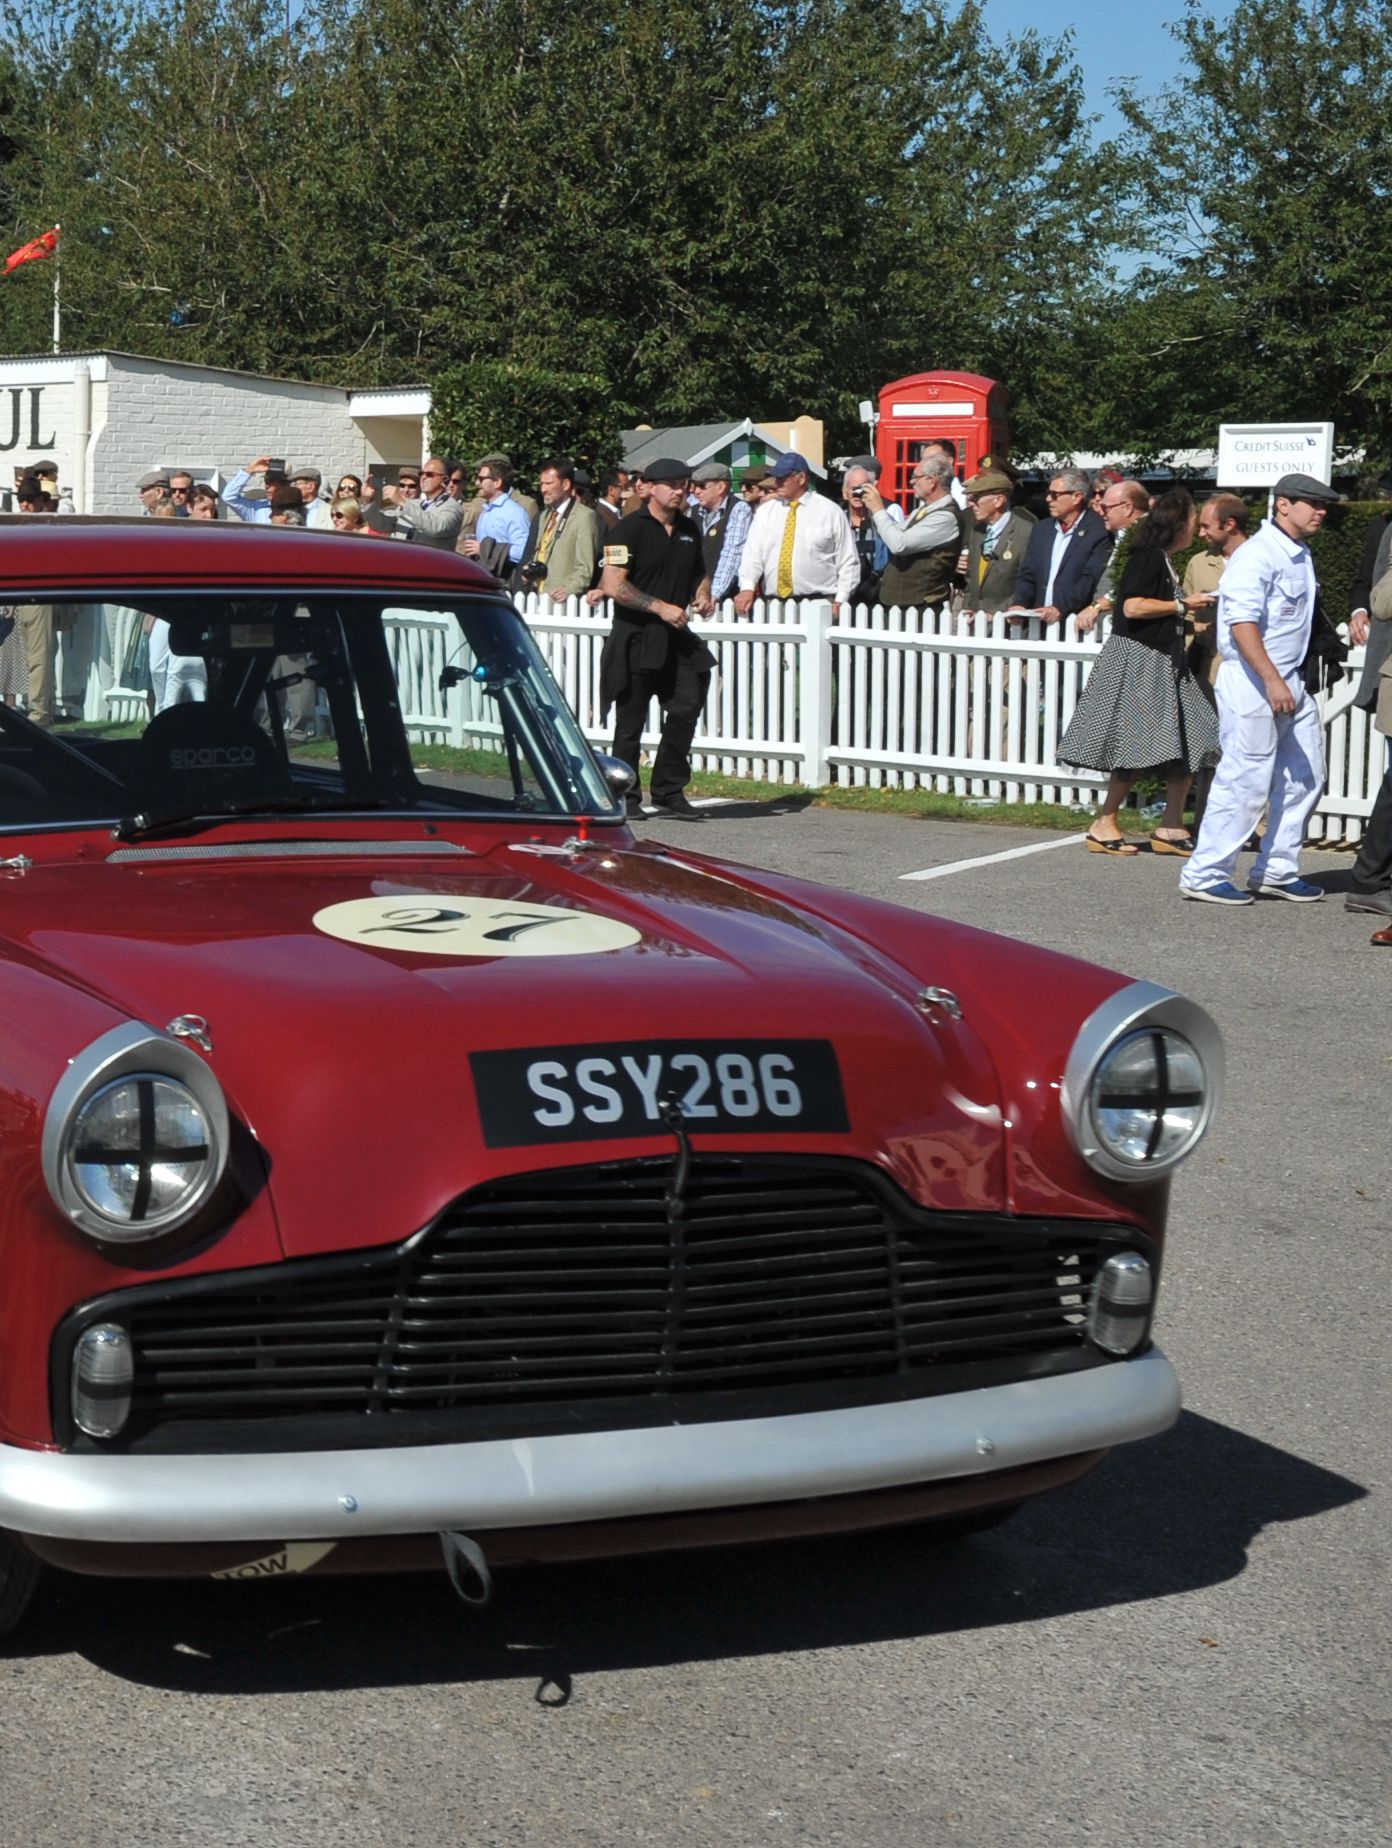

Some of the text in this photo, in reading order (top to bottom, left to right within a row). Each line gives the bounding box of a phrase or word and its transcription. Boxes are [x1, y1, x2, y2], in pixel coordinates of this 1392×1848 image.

[1234, 440, 1305, 452] CREDIT SUISSE
[1236, 462, 1315, 473] GUESTS ONLY
[170, 746, 256, 770] sparco
[358, 907, 582, 942] 27
